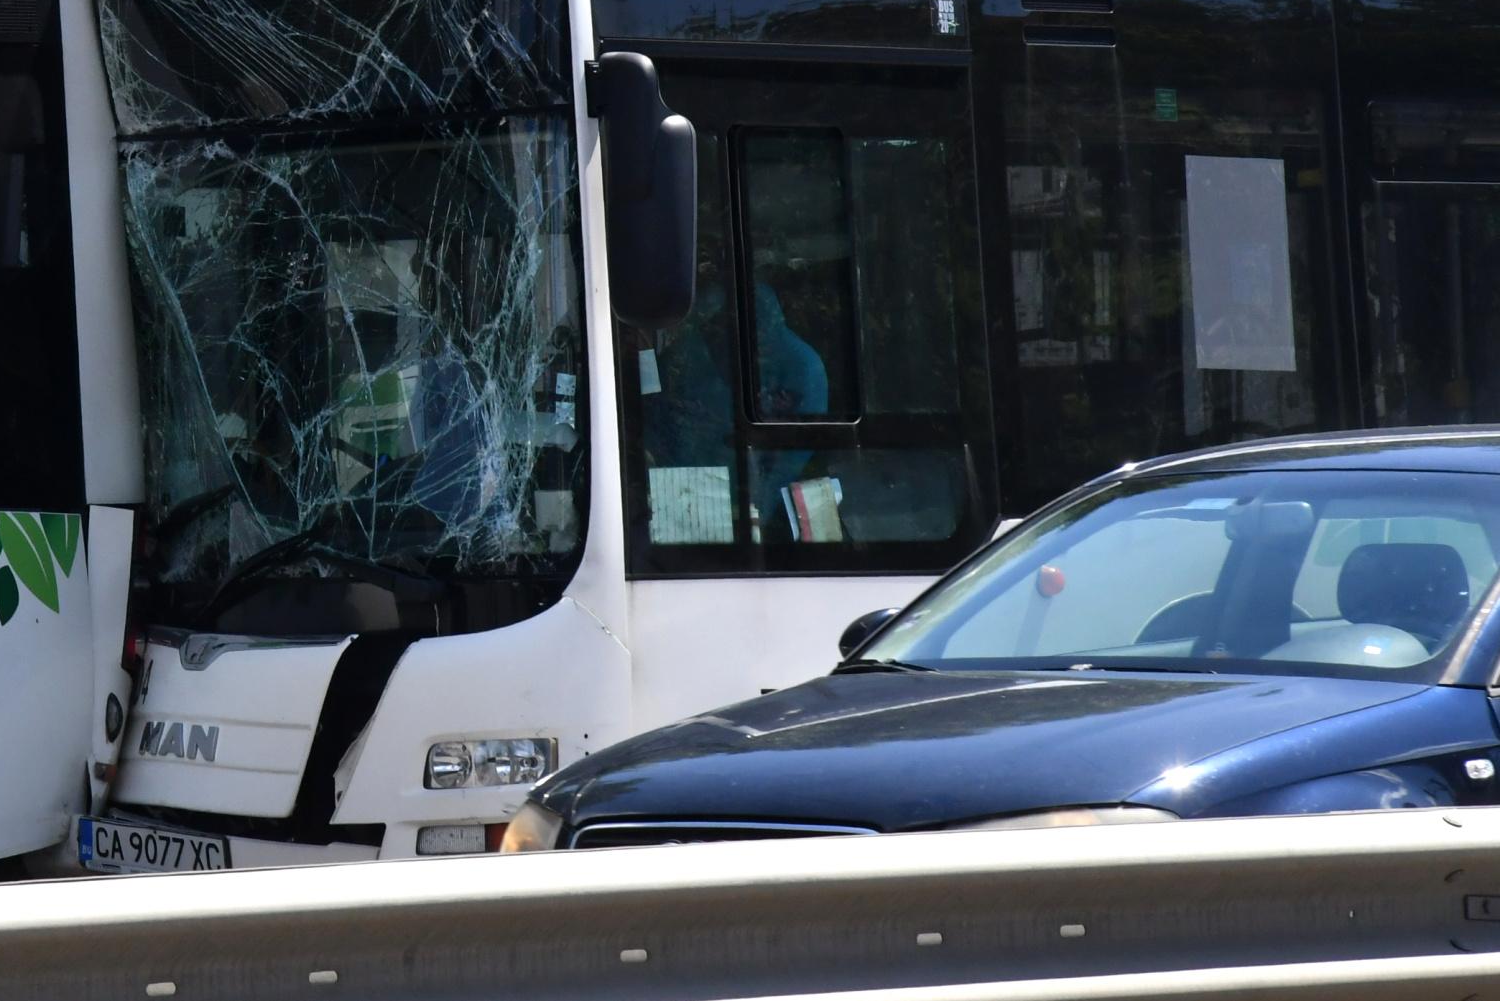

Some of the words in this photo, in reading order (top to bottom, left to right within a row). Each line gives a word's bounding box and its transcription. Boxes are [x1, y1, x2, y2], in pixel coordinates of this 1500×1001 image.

[938, 0, 955, 13] BUS
[139, 721, 220, 762] MAN
[95, 827, 125, 861] CA
[129, 831, 186, 868] 9077
[190, 840, 221, 870] XC
